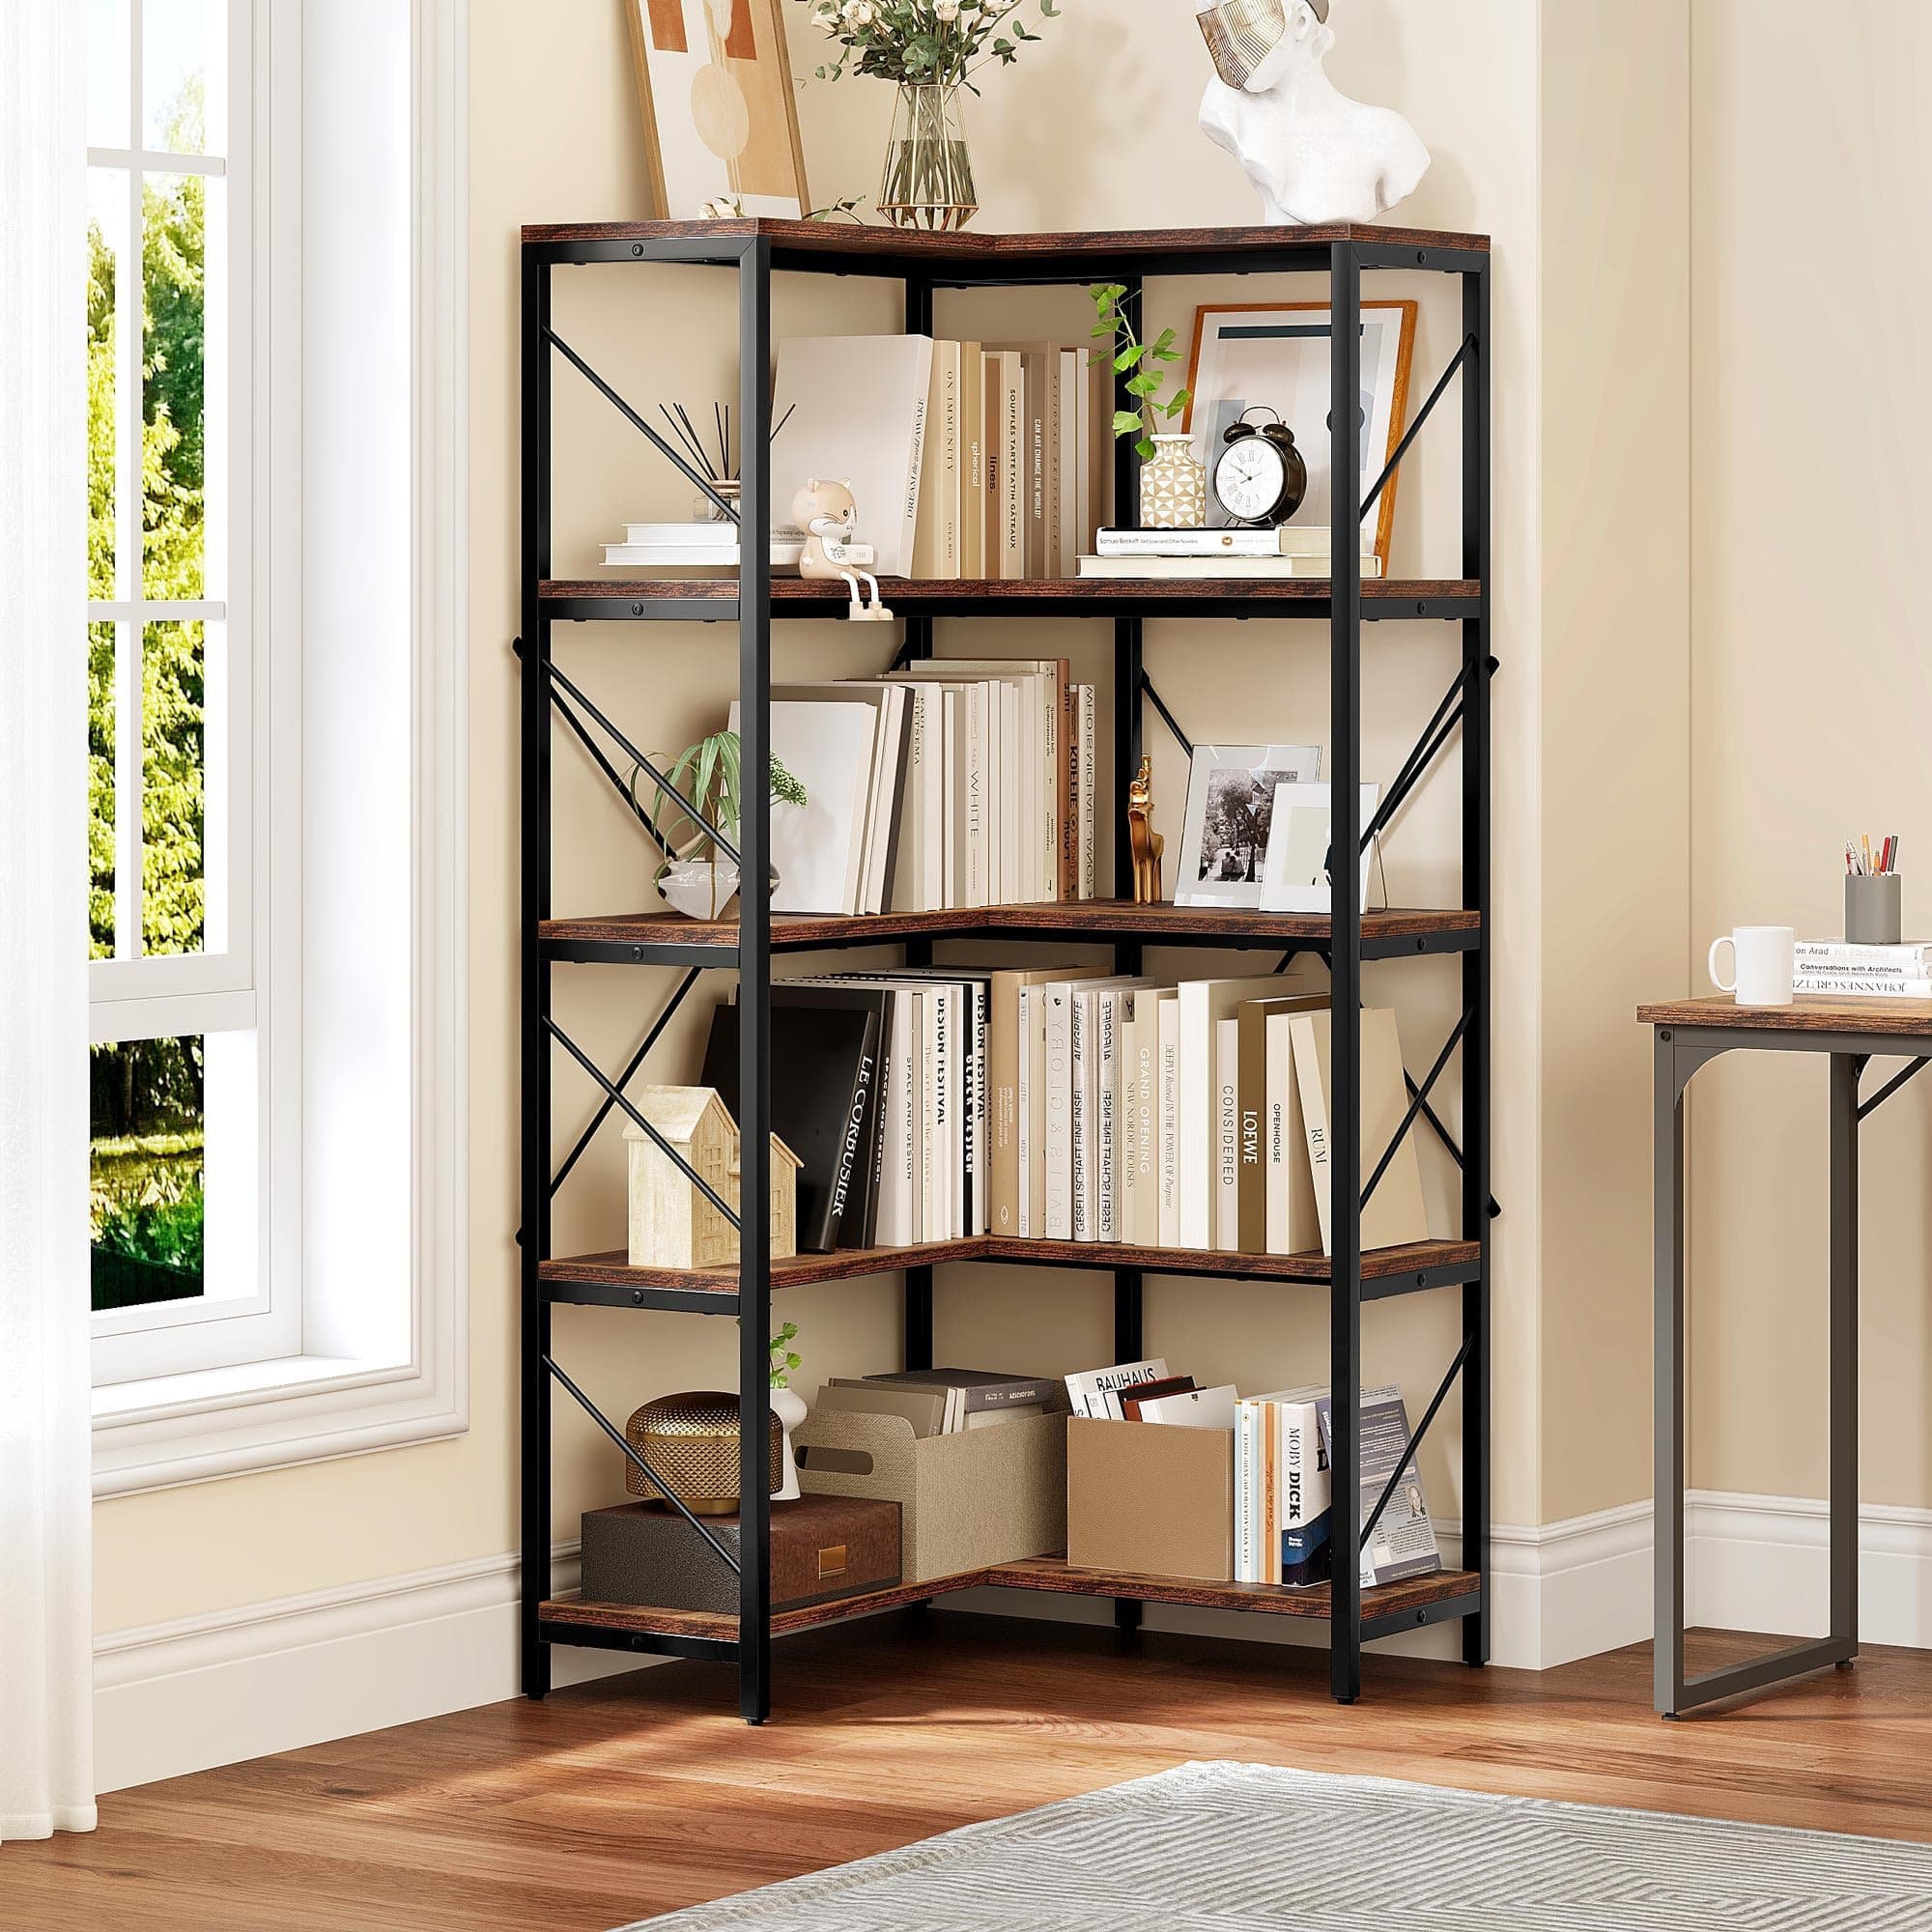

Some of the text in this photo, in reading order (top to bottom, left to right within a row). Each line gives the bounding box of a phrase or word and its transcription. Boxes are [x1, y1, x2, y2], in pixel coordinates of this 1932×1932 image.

[946, 371, 954, 472] ON IMMUNITY
[1009, 388, 1018, 436] SOUFFLÉS
[906, 475, 917, 520] DREAM
[915, 397, 924, 440] AWAKE
[970, 440, 980, 487] spherical
[988, 455, 997, 494] lines.
[1009, 503, 1018, 550] GÂTEAUX
[970, 770, 980, 838] WHITE
[1800, 963, 1849, 972] Conversations
[1809, 947, 1829, 955] Arad
[1840, 981, 1907, 992] JOHANNES
[965, 1054, 974, 1173] BLACK DESIGN
[977, 1055, 985, 1121] FESTIVAL
[1139, 1048, 1151, 1174] GRAND OPENING
[832, 1056, 873, 1217] LE CORBUSIER
[1126, 1082, 1135, 1188] NEW NORDIC HOUSES
[1163, 1043, 1175, 1209] DEEPLY Rooted IN THE POWER OF Purpose.
[1222, 1085, 1234, 1185] CONSIDERED
[1242, 1111, 1258, 1164] LOEWE
[1272, 1103, 1281, 1164] OPENHOUSE
[1311, 1127, 1327, 1164] RUM
[874, 1134, 883, 1182] DESIGN
[1074, 1147, 1085, 1233] GESELLSCHAFT
[1095, 1367, 1156, 1391] BAUHAUS
[1289, 1427, 1300, 1520] MOBY DICK
